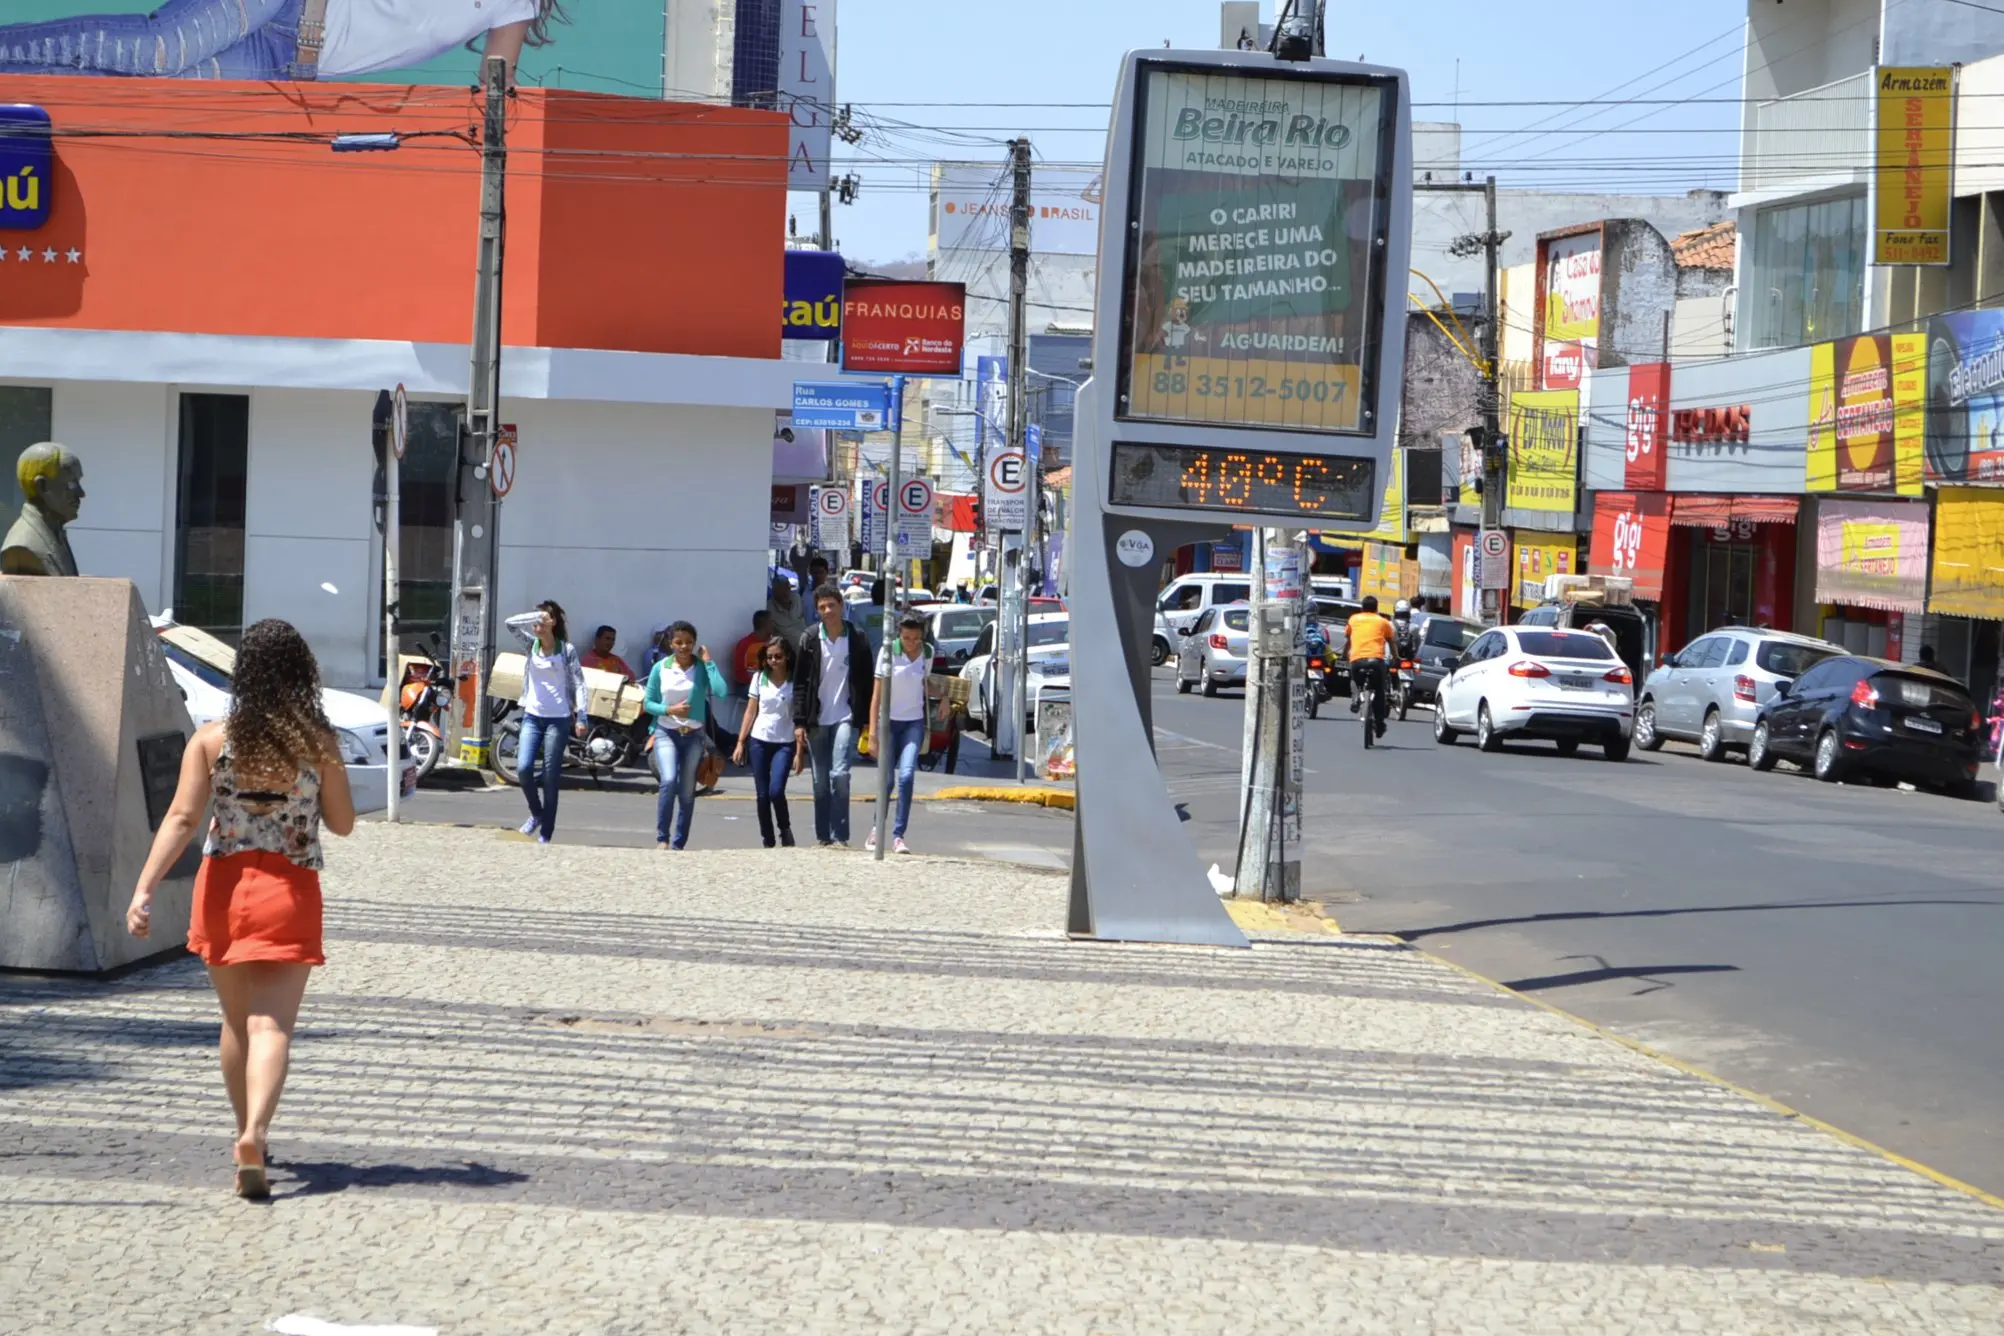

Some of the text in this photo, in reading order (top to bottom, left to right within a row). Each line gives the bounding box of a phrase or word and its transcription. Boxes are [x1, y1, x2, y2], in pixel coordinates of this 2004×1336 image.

[1881, 72, 1948, 91] Armazém
[1204, 98, 1290, 115] MADEIREIRA
[1172, 107, 1351, 150] Beira Rio
[1186, 152, 1334, 171] ATACADO E VAREJO
[1904, 97, 1922, 228] SERTANEJO
[0, 166, 39, 210] ú
[1210, 203, 1296, 225] O CARIRI
[1189, 225, 1323, 252] MERECE UMA
[1177, 249, 1337, 279] MADEIREIRA DO
[1177, 284, 1216, 303] SEU
[844, 302, 962, 320] FRANQUIAS
[1220, 332, 1344, 353] AGUARDEM!
[1549, 354, 1579, 380] Tany
[795, 386, 815, 395] Rua
[1153, 371, 1347, 402] 88 3512-5007
[795, 398, 869, 408] CARLOS GOMES
[1627, 395, 1657, 462] gigi
[1002, 461, 1020, 484] E
[828, 495, 838, 510] E
[908, 487, 923, 506] E
[1489, 538, 1500, 552] E
[1612, 511, 1643, 577] gigi
